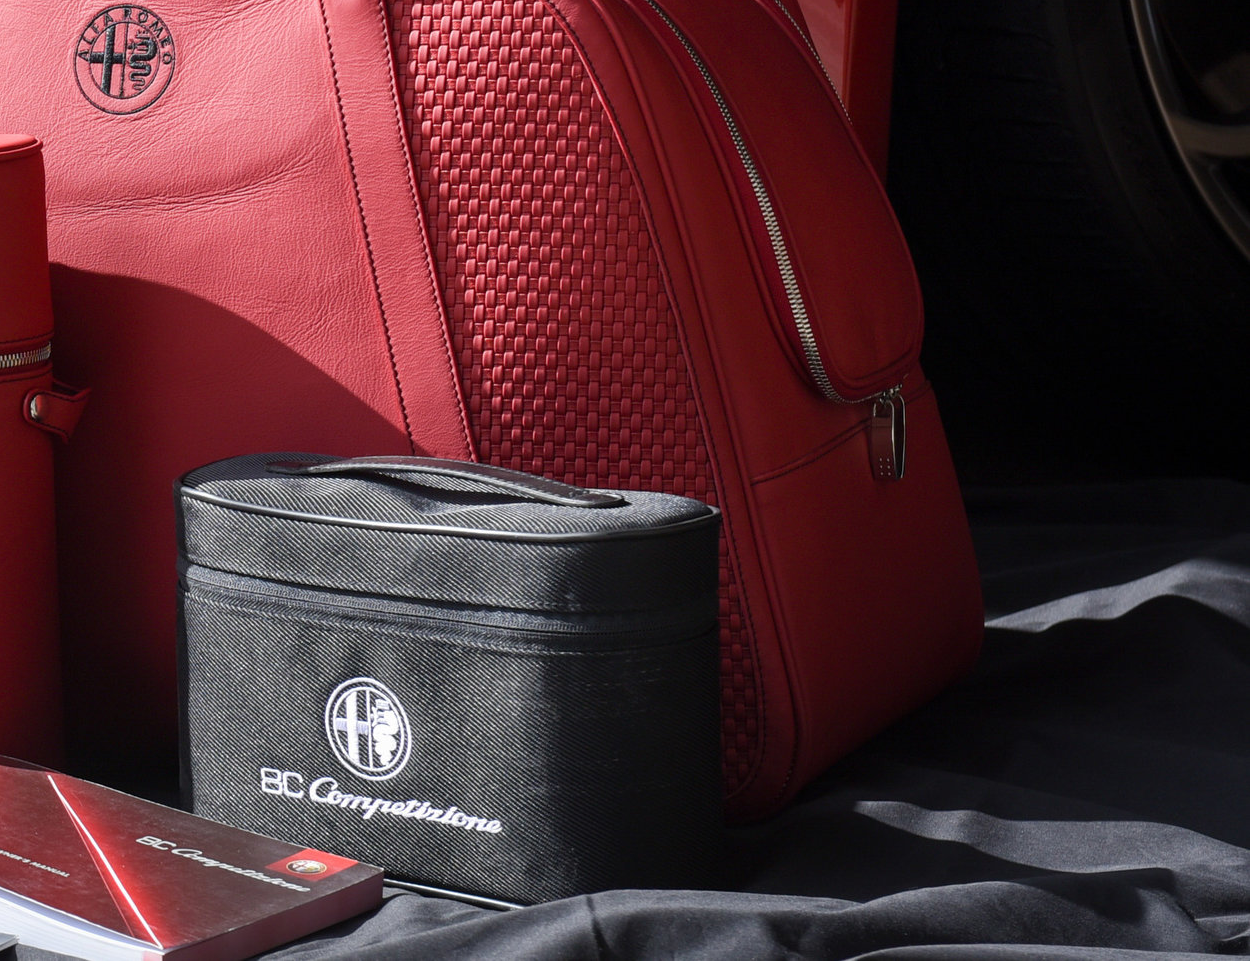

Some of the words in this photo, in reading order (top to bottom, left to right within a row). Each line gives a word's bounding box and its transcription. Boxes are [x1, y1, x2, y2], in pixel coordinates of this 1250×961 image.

[77, 11, 114, 61] ALFA
[123, 7, 174, 65] ROMEO
[309, 776, 503, 834] Competizione
